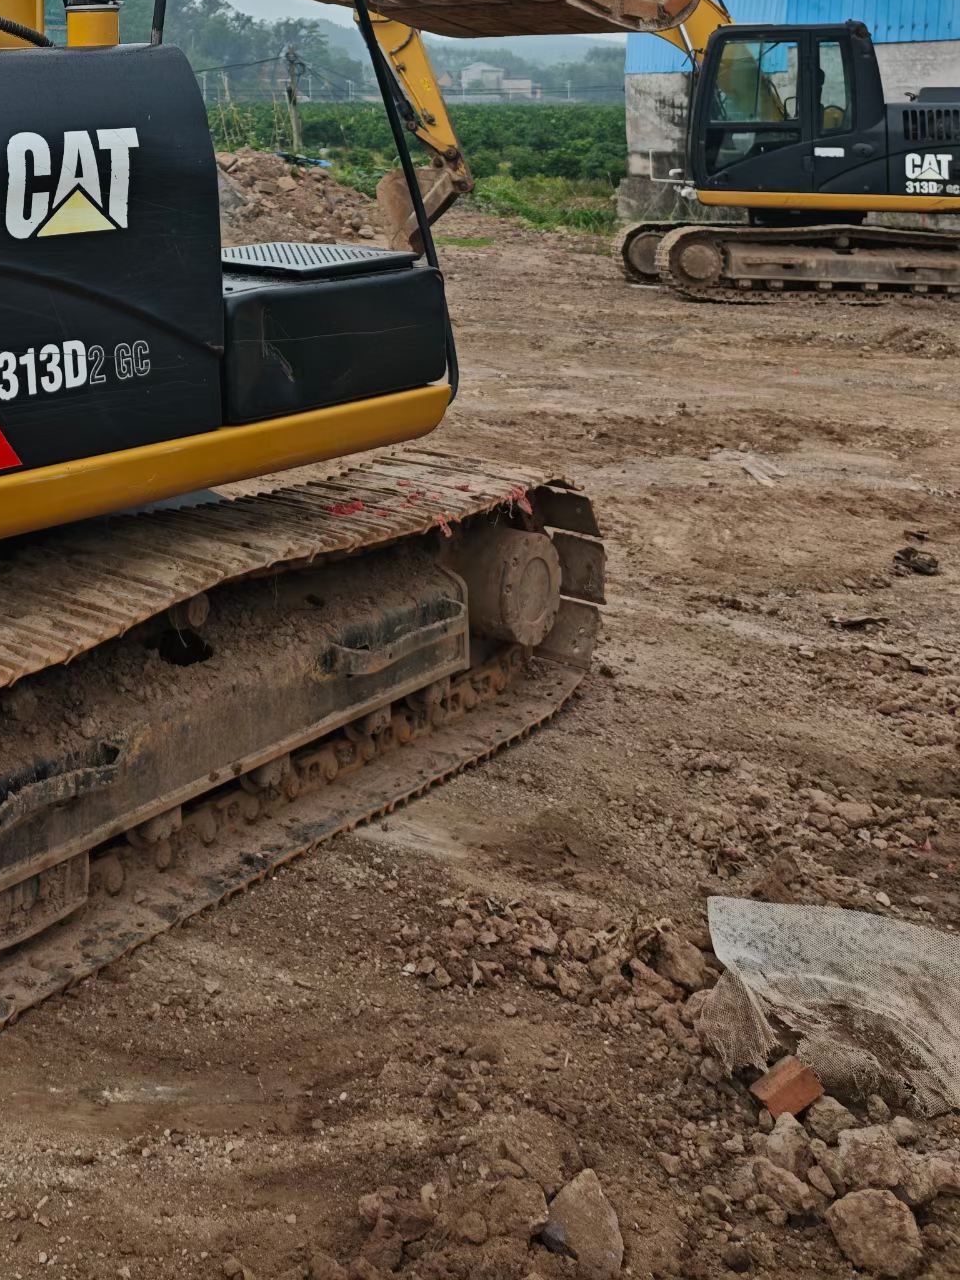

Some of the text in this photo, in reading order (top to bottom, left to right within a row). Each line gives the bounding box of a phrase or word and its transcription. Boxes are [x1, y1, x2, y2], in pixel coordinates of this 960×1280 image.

[5, 127, 140, 239] CAT
[905, 152, 953, 180] CAT
[114, 340, 151, 380] GC
